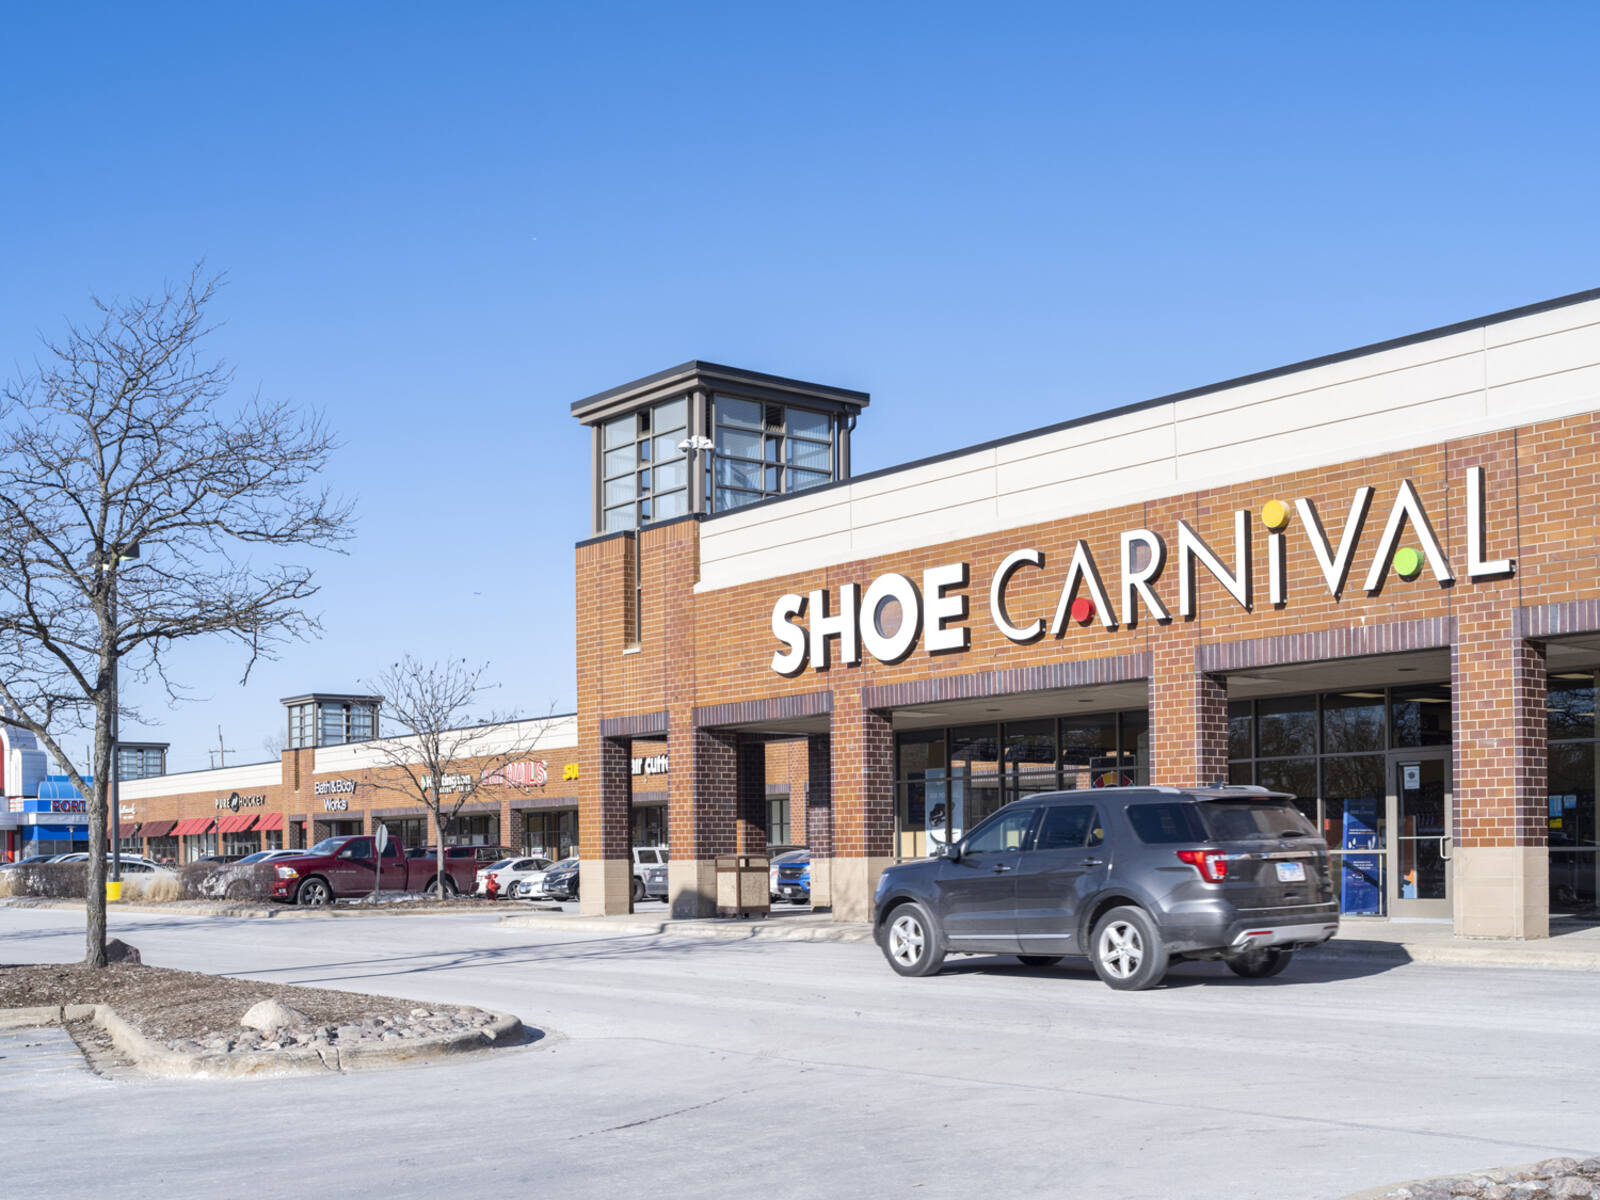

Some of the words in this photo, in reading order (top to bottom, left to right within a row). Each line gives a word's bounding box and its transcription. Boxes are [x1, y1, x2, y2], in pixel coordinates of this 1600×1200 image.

[771, 562, 971, 678] SHOE
[426, 773, 472, 789] Htington
[506, 761, 547, 787] NAILS
[215, 798, 231, 810] PURE
[239, 794, 266, 808] HOCKEY
[323, 798, 348, 812] Works
